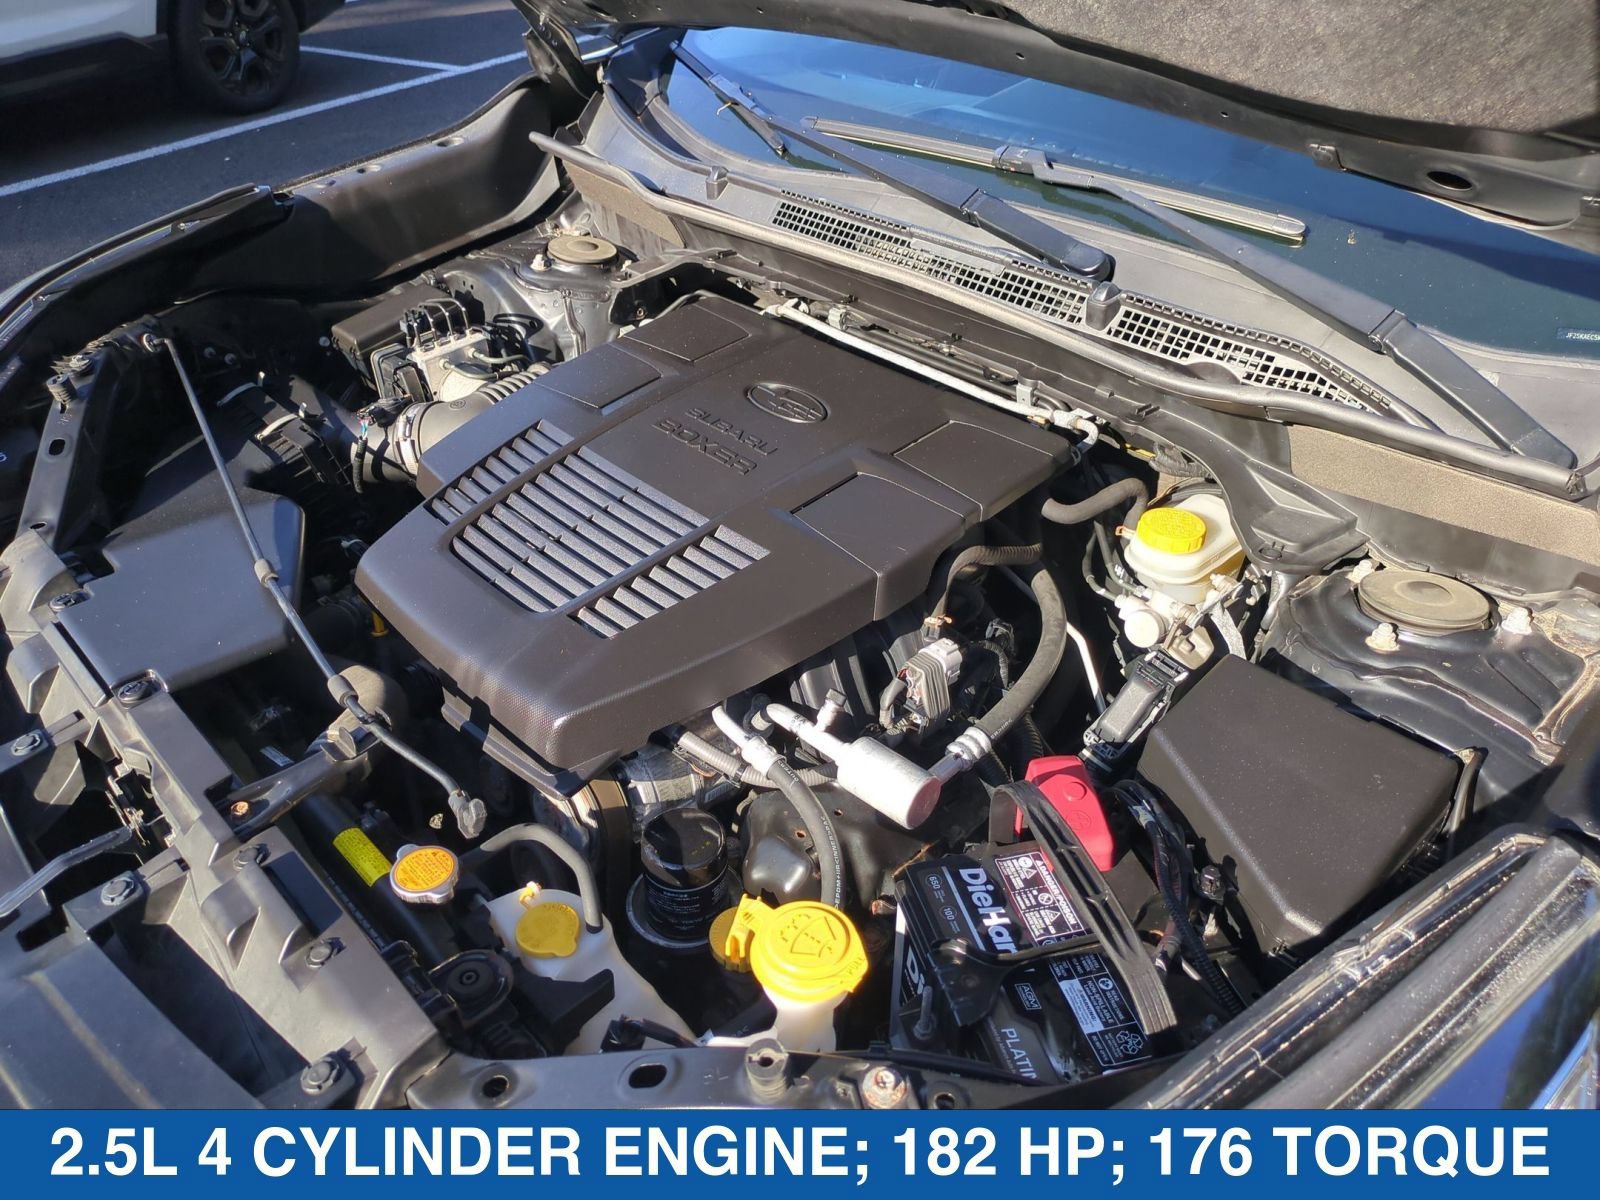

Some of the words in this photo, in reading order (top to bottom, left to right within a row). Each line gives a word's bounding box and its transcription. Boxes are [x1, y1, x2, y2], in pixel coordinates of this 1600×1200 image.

[651, 418, 758, 476] BOXER
[684, 407, 778, 456] SUBARU
[928, 876, 941, 890] 650
[943, 906, 955, 921] 100
[958, 867, 1018, 955] DieHar
[1021, 985, 1039, 1008] AGM
[1086, 980, 1115, 1024] NON-SPILLABLE
